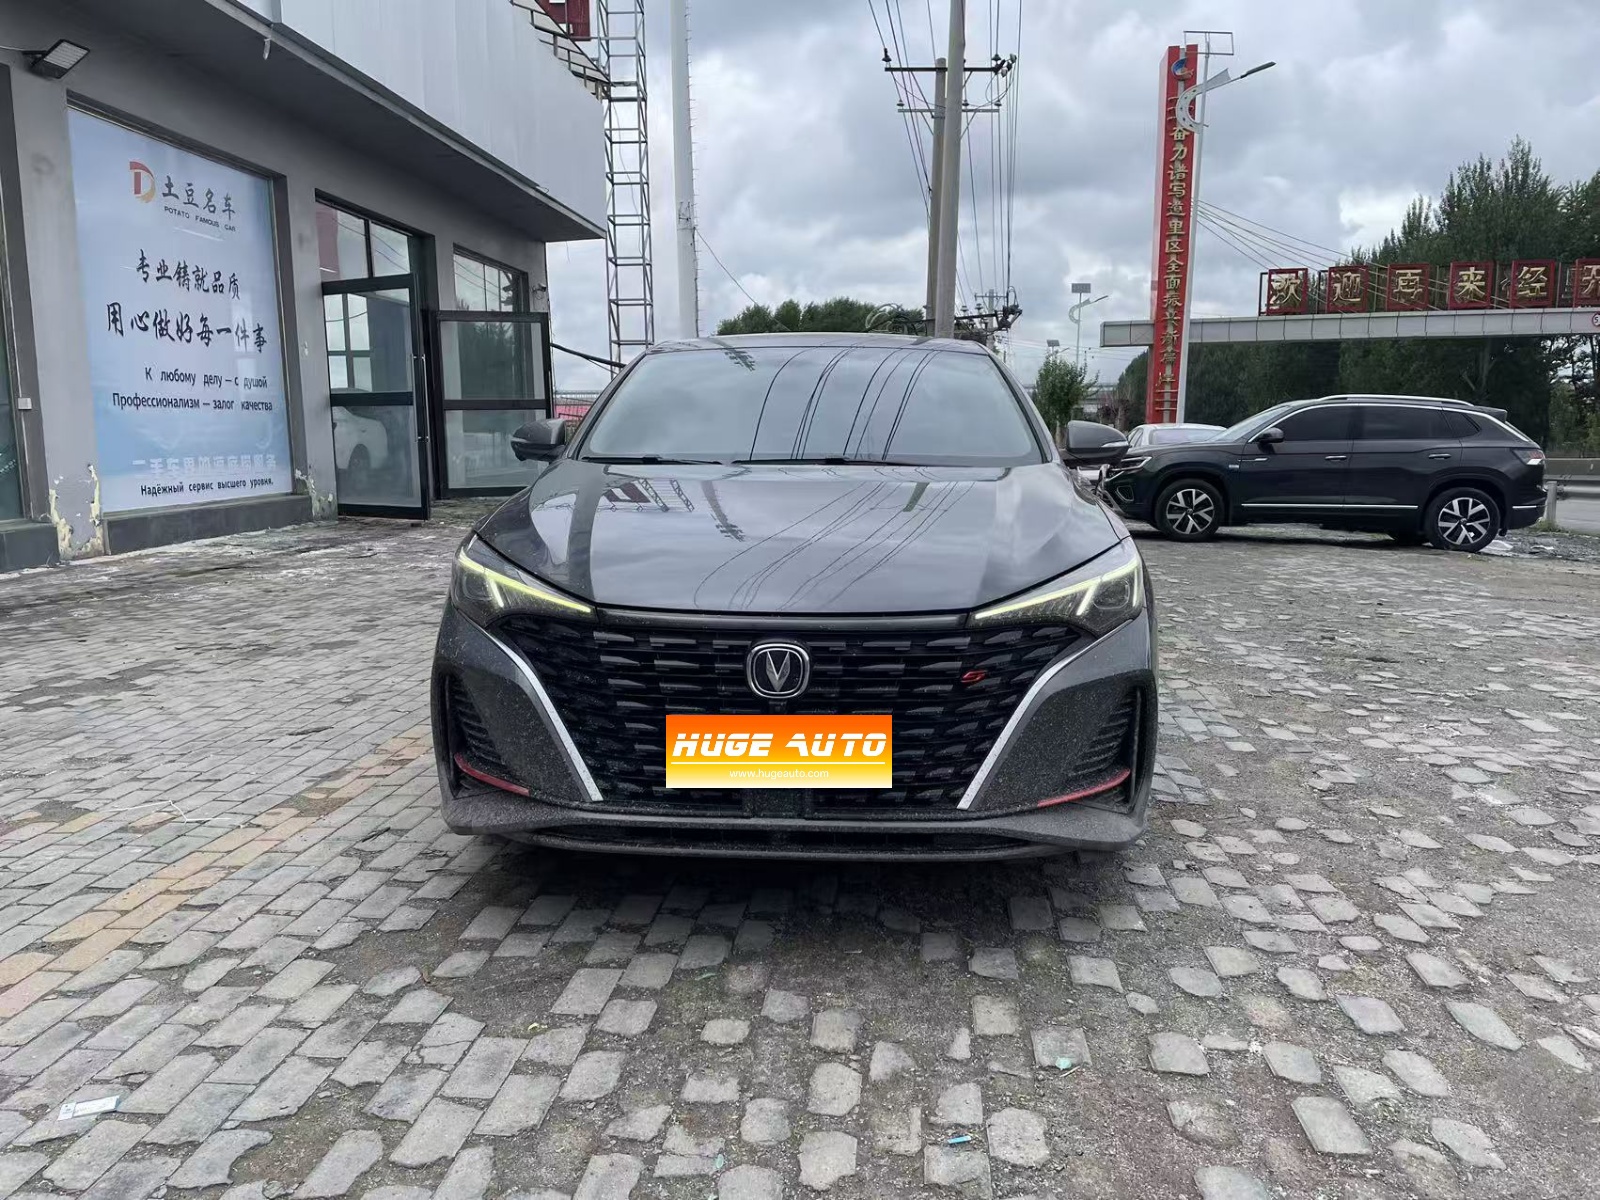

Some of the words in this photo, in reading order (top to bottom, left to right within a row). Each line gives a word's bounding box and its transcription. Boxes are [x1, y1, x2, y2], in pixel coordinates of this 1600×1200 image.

[161, 175, 236, 220] 土豆名车
[164, 206, 190, 219] POTATO
[195, 215, 220, 228] FAMOUS
[224, 224, 236, 233] CAR
[136, 248, 241, 300] 专业铸就品质
[106, 302, 268, 354] 用心做好每一件事
[145, 367, 152, 380] К
[160, 369, 196, 386] любому
[203, 373, 223, 389] делу
[243, 376, 268, 390] душой
[112, 393, 200, 411] Профессионализм
[212, 399, 235, 411] залог
[240, 400, 273, 412] качества
[140, 482, 184, 497] Надёжный
[188, 482, 214, 494] сервис
[217, 479, 247, 490] высшего
[250, 476, 274, 487] уровня.
